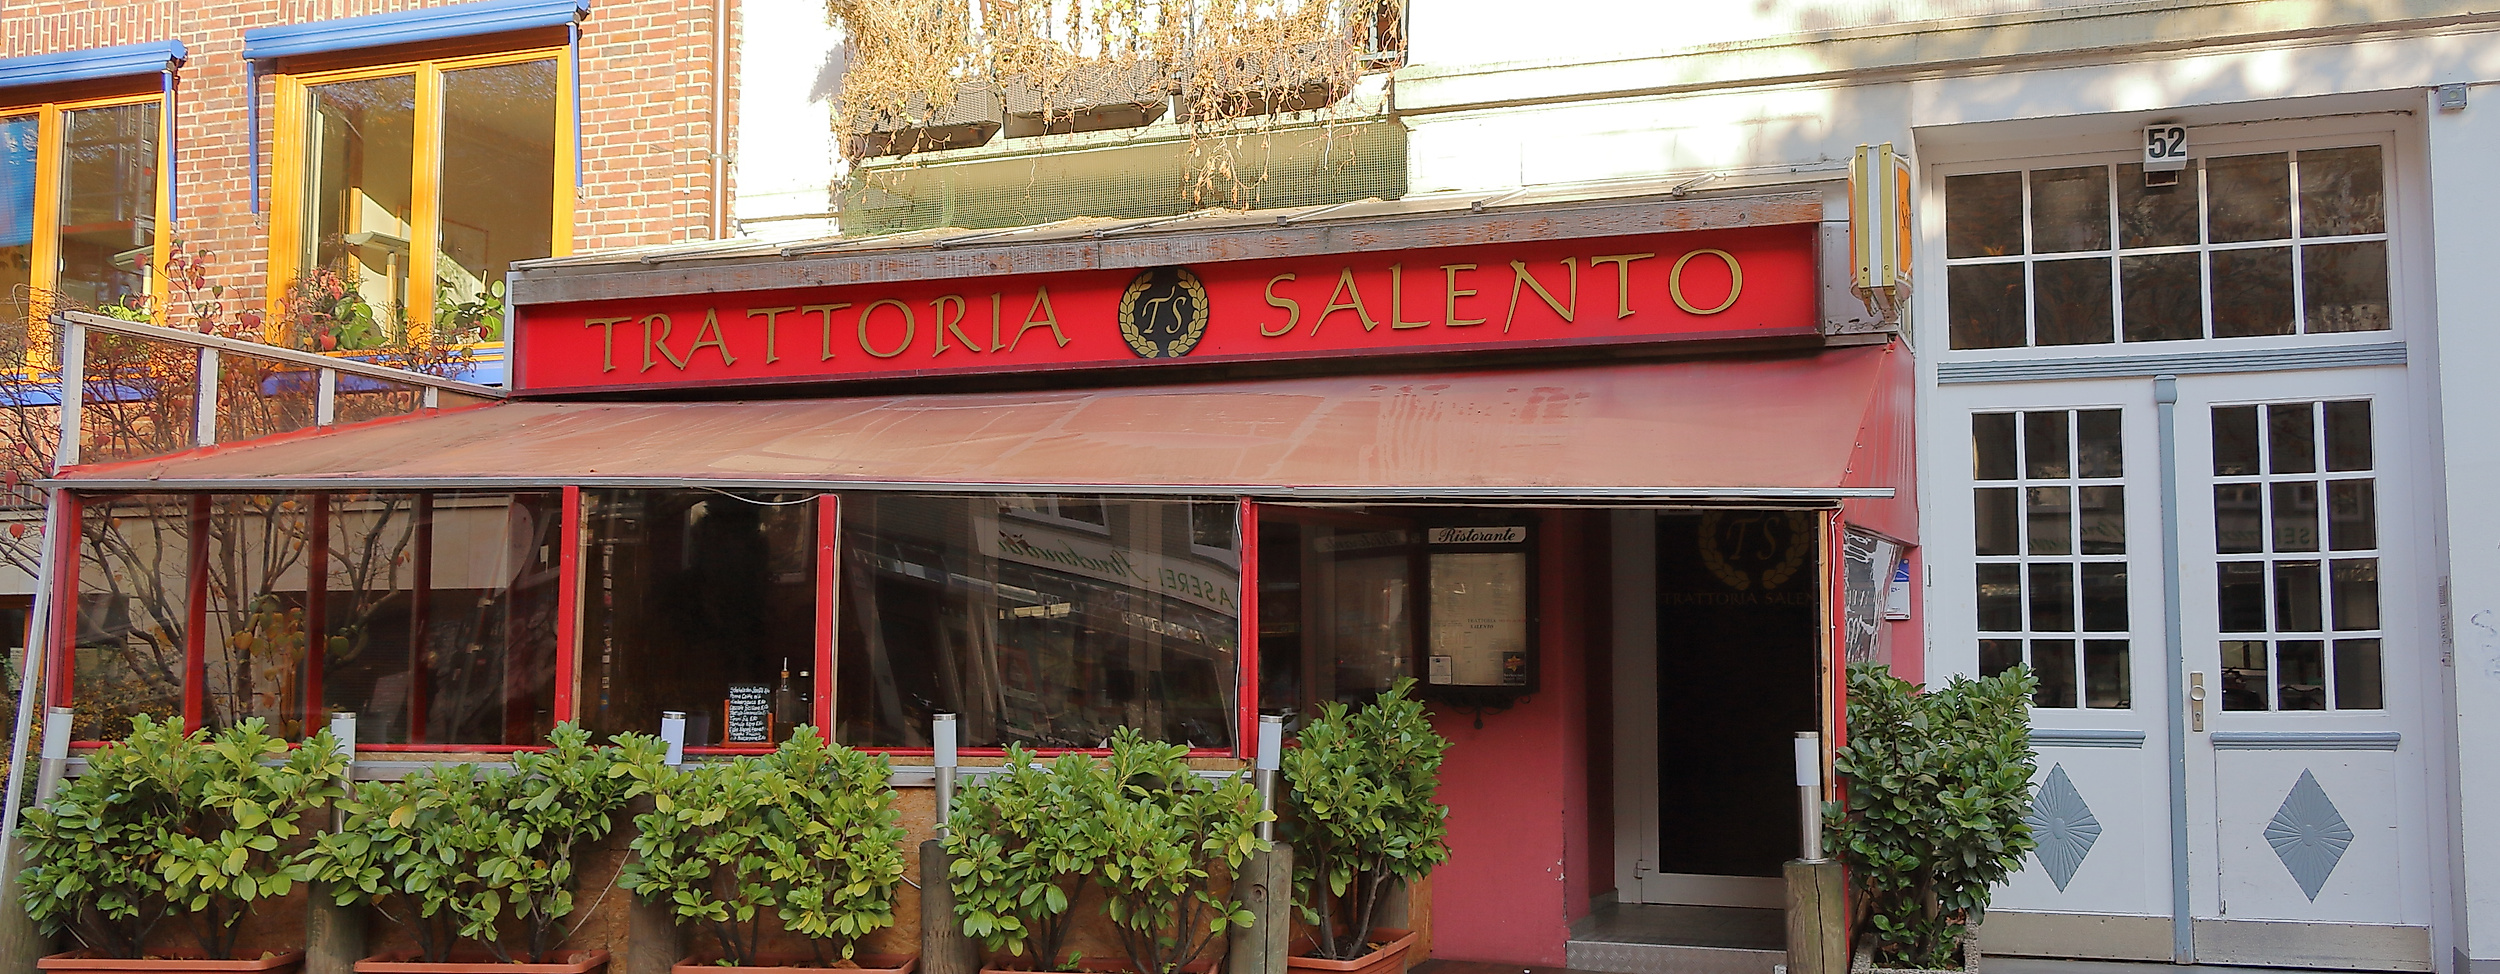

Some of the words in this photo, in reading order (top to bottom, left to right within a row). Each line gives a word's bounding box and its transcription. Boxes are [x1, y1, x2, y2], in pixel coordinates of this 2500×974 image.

[2147, 126, 2185, 158] 52
[584, 287, 1072, 374] TRATTORIA
[1260, 248, 1744, 338] SALENTO
[1142, 285, 1187, 334] TS
[1438, 527, 1516, 542] Ristorante
[1661, 591, 1758, 606] TRATTORIA
